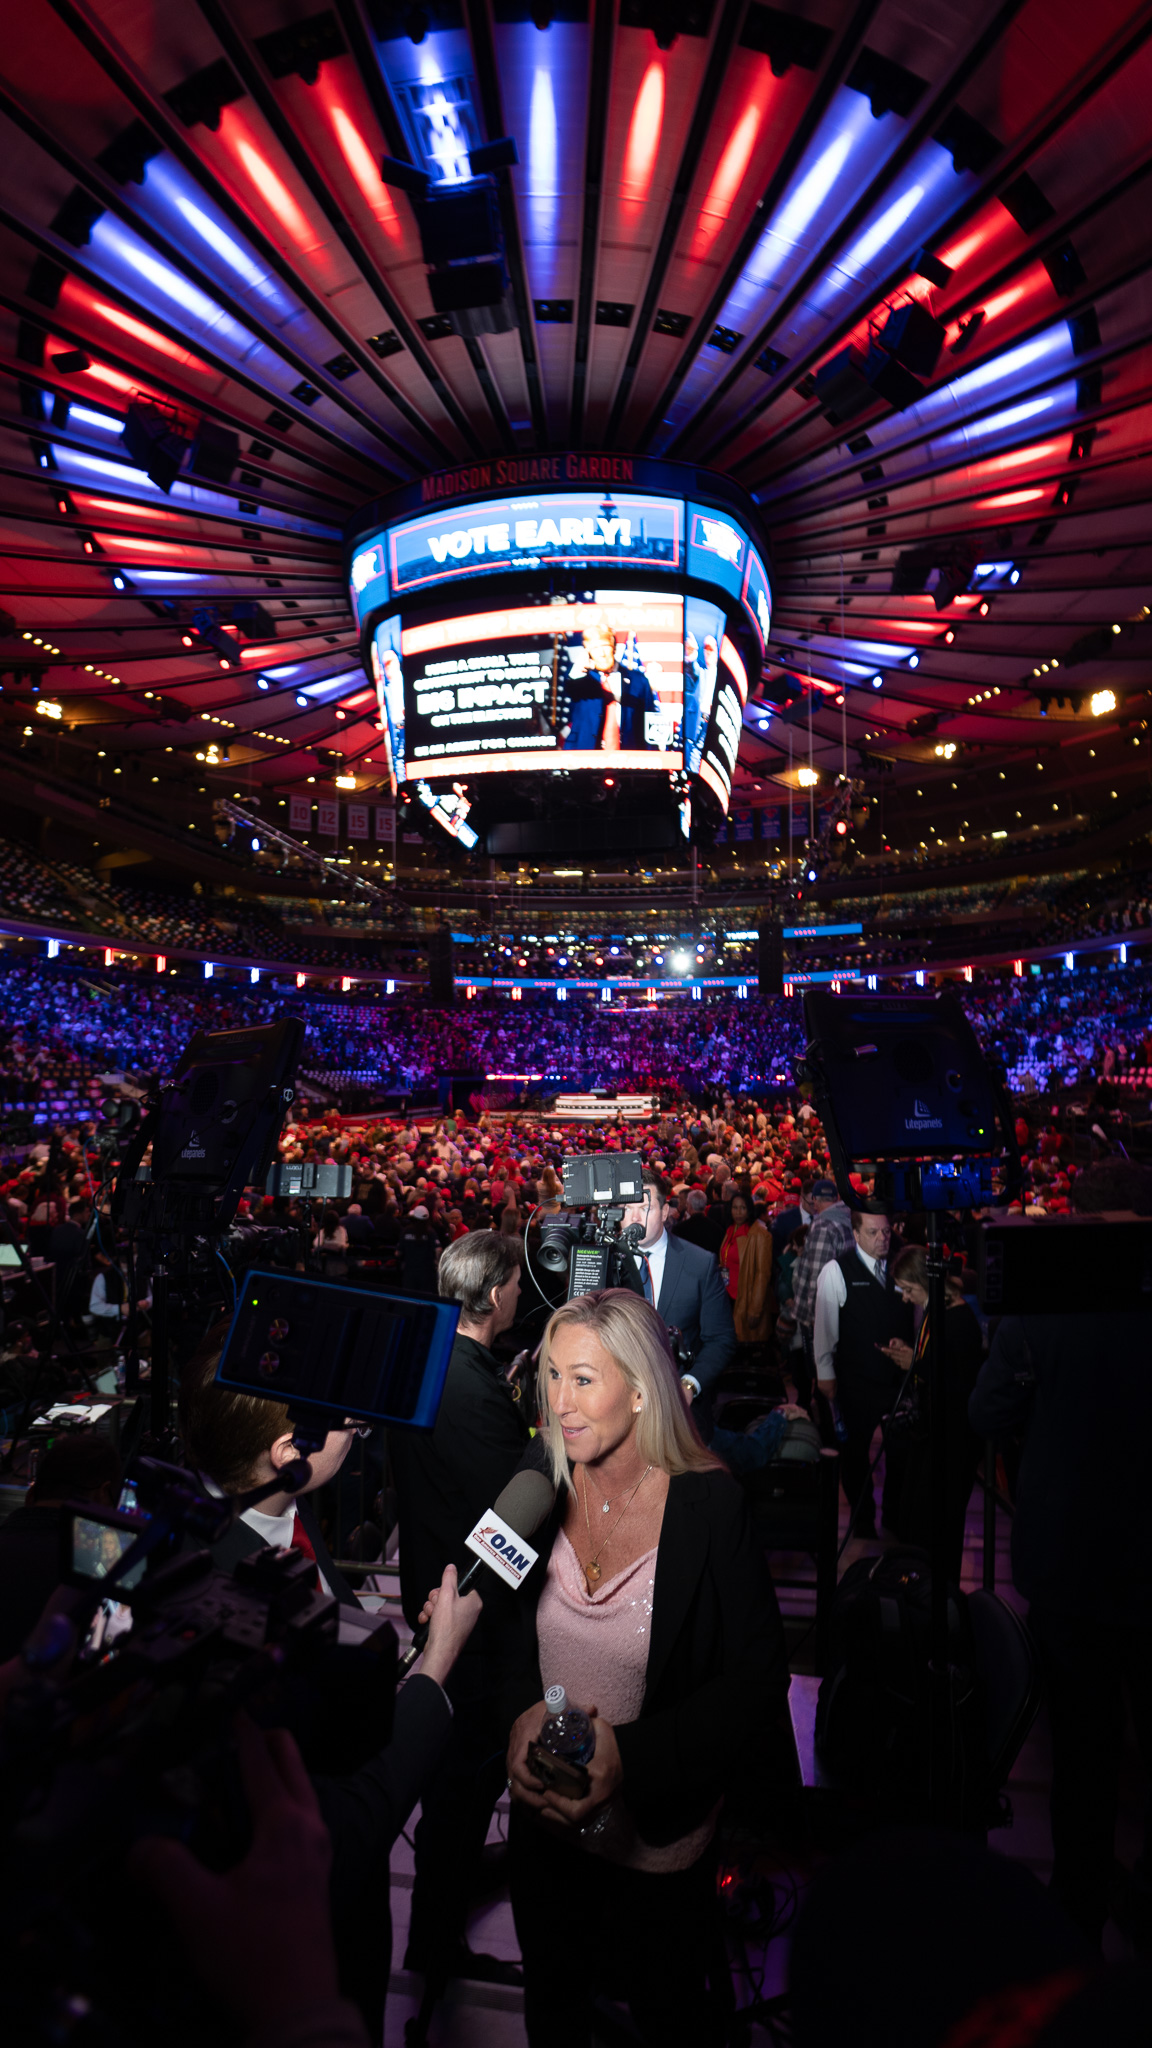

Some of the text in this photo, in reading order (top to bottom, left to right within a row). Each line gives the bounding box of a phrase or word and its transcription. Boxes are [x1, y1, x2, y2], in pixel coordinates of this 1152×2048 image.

[422, 454, 633, 501] MADISON SQUARE GARDEN
[428, 518, 631, 562] VOTE EARLY!
[457, 681, 549, 709] IMPACT
[293, 806, 308, 820] 10
[321, 810, 336, 824] 12
[351, 815, 366, 828] 15
[379, 818, 393, 831] 15
[904, 1118, 943, 1130] Litepanels
[490, 1533, 530, 1572] OAN
